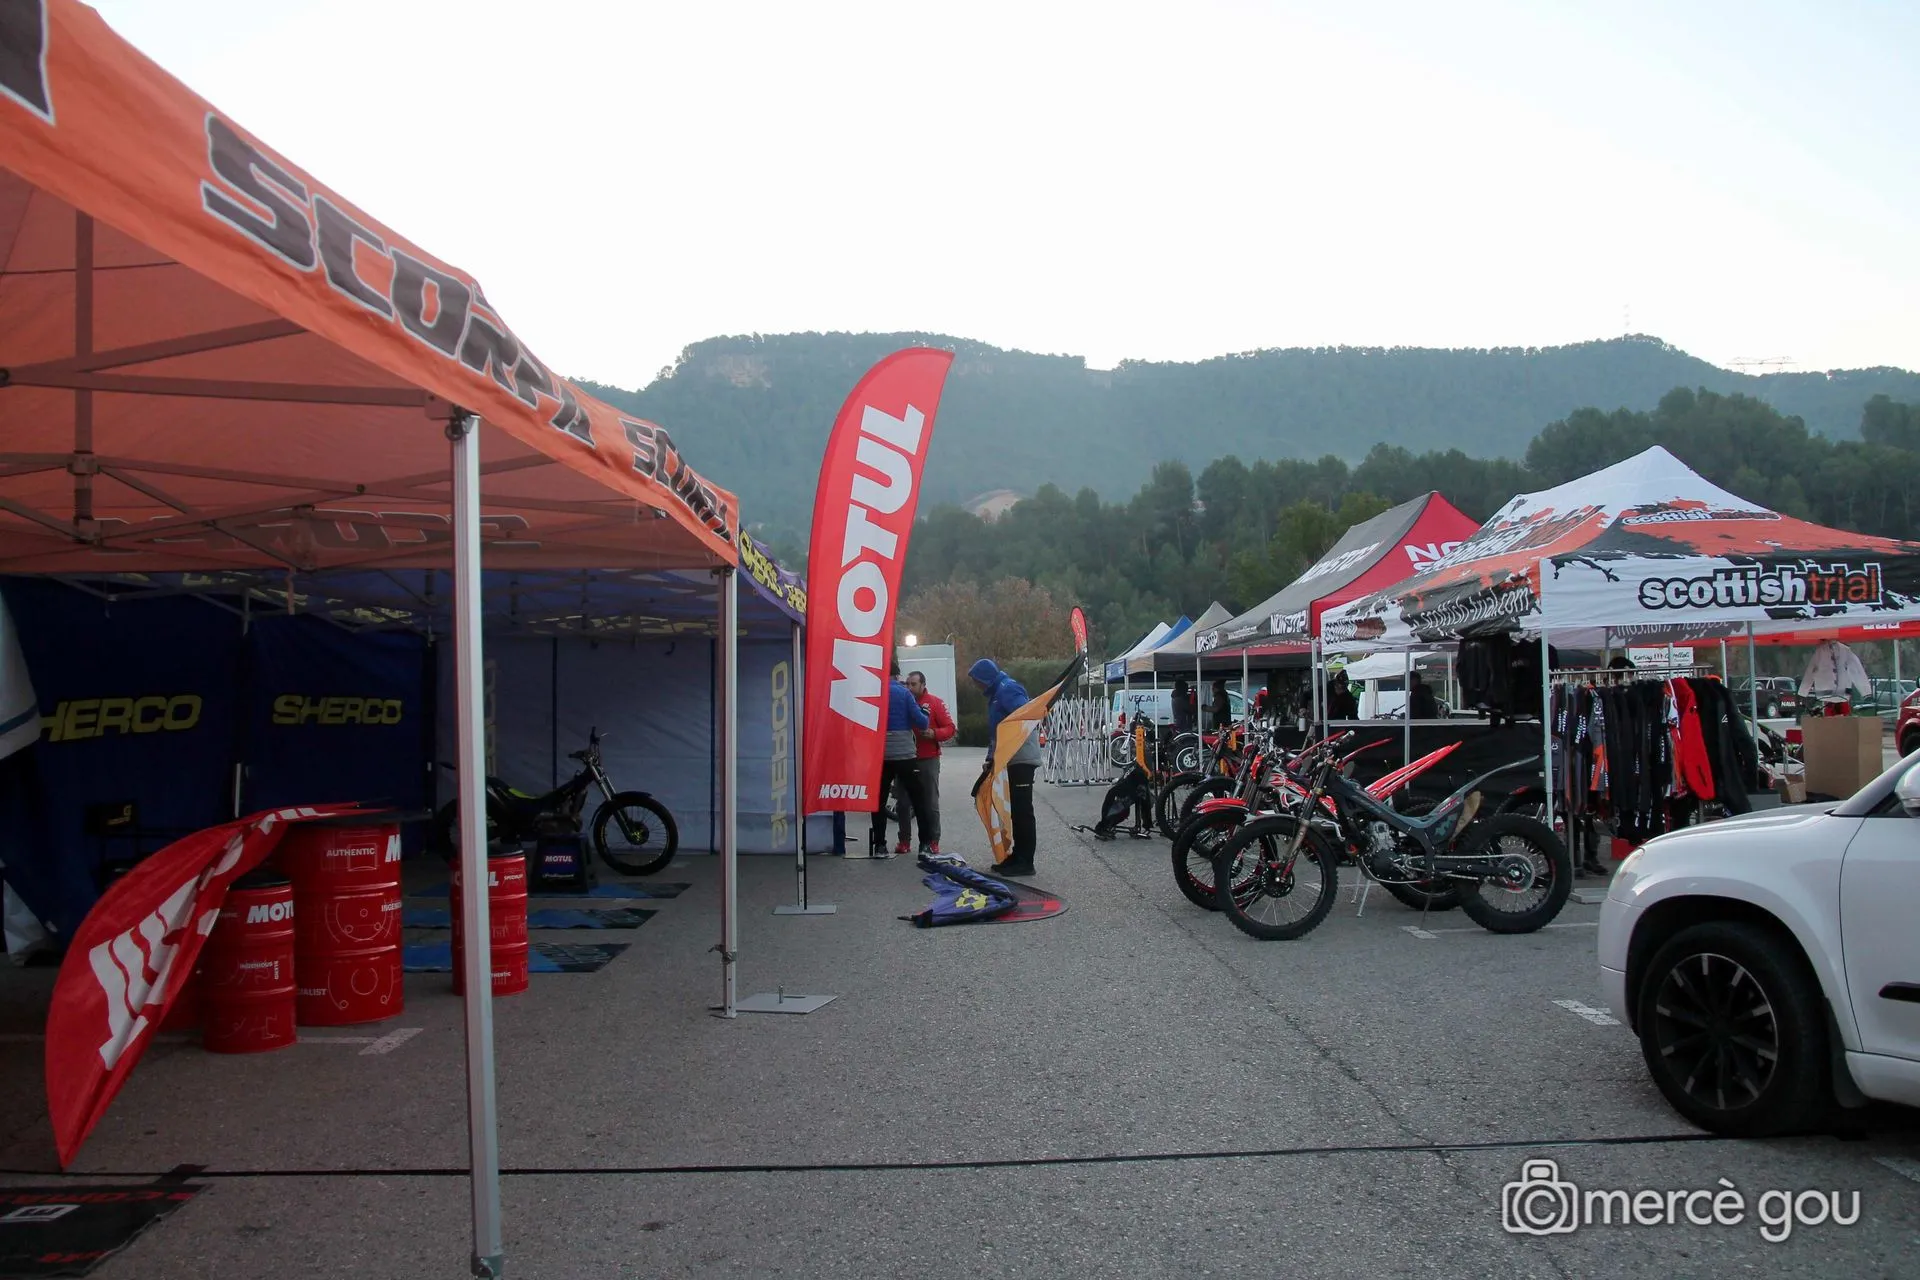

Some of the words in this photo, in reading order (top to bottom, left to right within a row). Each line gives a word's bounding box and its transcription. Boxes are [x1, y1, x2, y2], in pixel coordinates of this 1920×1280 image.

[829, 403, 926, 732] MOTUL
[39, 694, 203, 743] HERCO
[272, 694, 402, 725] SHERCO
[818, 783, 869, 800] MOTUL
[325, 846, 376, 859] AUTHENTIC
[544, 855, 575, 864] MOTUL
